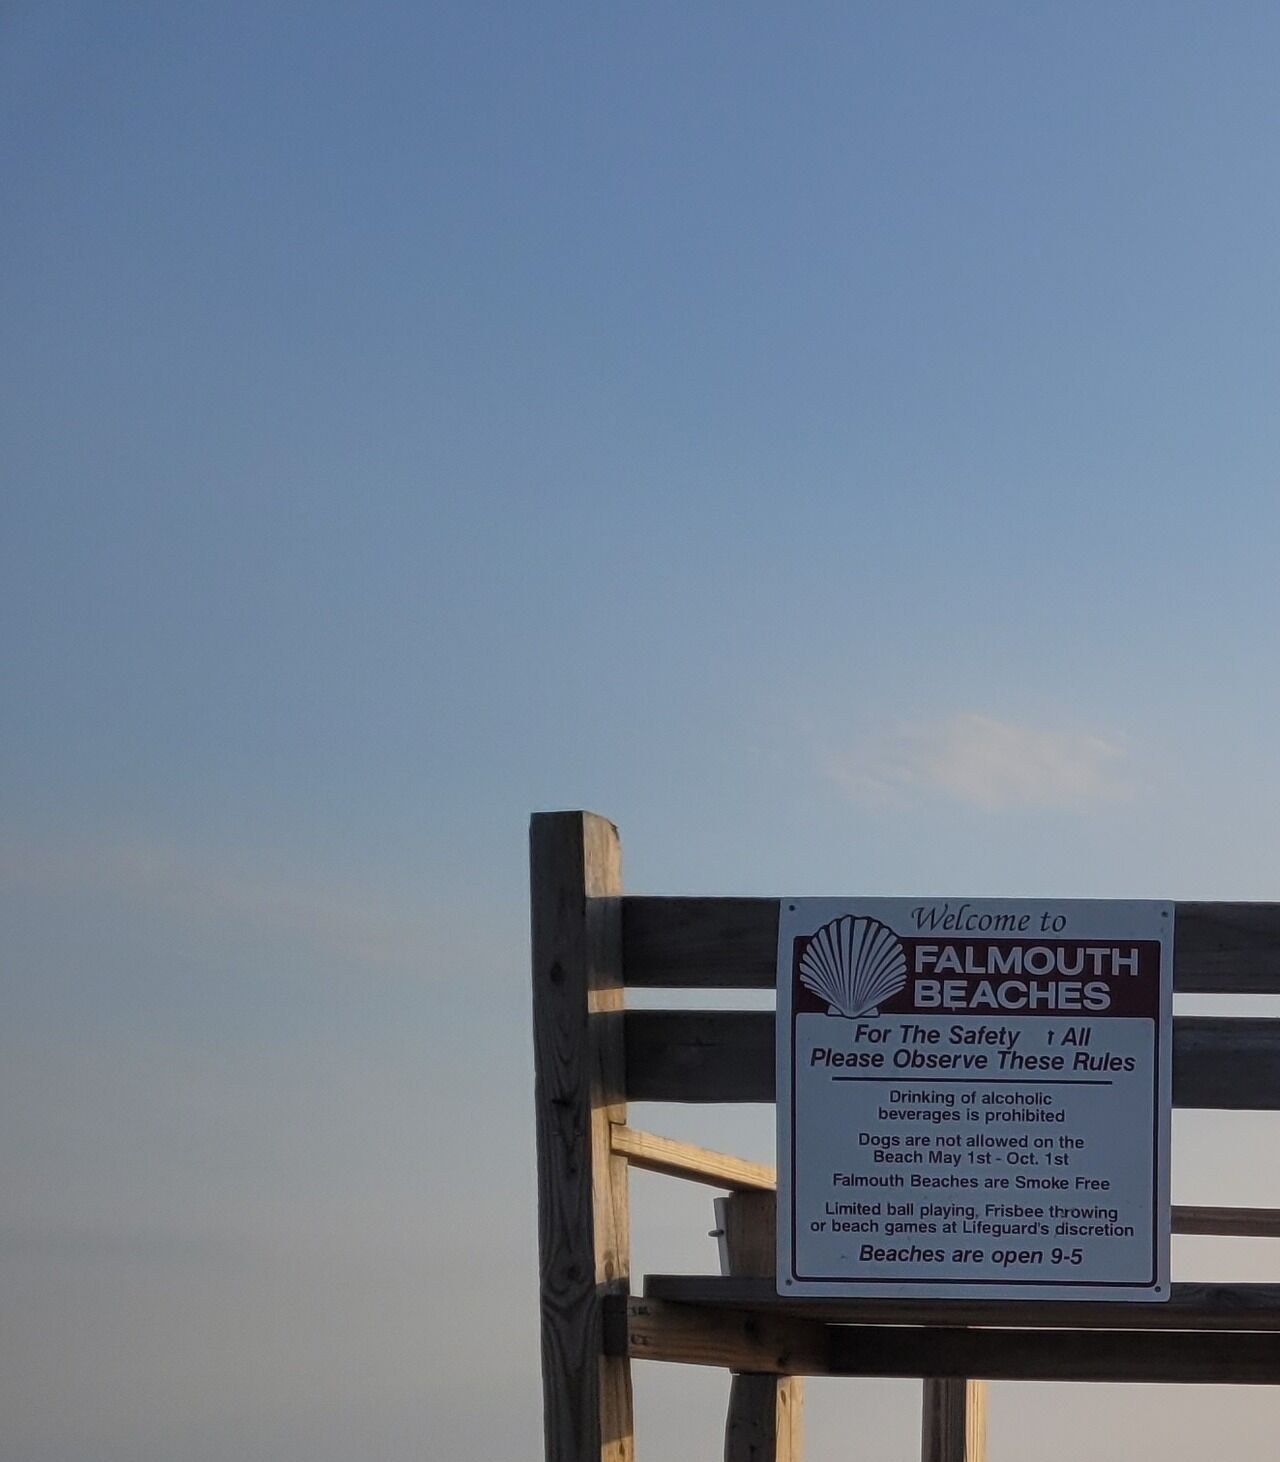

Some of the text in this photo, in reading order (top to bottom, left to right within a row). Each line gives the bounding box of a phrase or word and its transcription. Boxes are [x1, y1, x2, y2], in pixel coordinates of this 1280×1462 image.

[911, 904, 1066, 932] Welcome to
[914, 945, 1140, 976] FALMOUTH
[914, 980, 1111, 1010] BEACHES
[855, 1024, 891, 1044] For
[900, 1025, 940, 1045] The
[948, 1026, 1021, 1049] Safety
[1061, 1028, 1091, 1046] All
[810, 1049, 1135, 1072] Please Observe These Rules
[890, 1090, 1052, 1107] Drinking of alcoholic
[879, 1108, 1065, 1124] beverages is prohibited
[858, 1133, 1084, 1149] Dogs are not allowed on the
[874, 1150, 923, 1164] Beach
[928, 1151, 962, 1167] May
[968, 1151, 991, 1165] 1st
[1007, 1152, 1039, 1165] Oct.
[1045, 1153, 1069, 1166] 1st
[833, 1173, 1110, 1191] Falmouth Beaches are Smoke Free
[825, 1203, 1118, 1222] Limited ball playing, Frisbee throwing
[810, 1220, 1134, 1238] or beach games at Lifeguard's discretion
[859, 1245, 1083, 1268] Beaches are open 9-5
